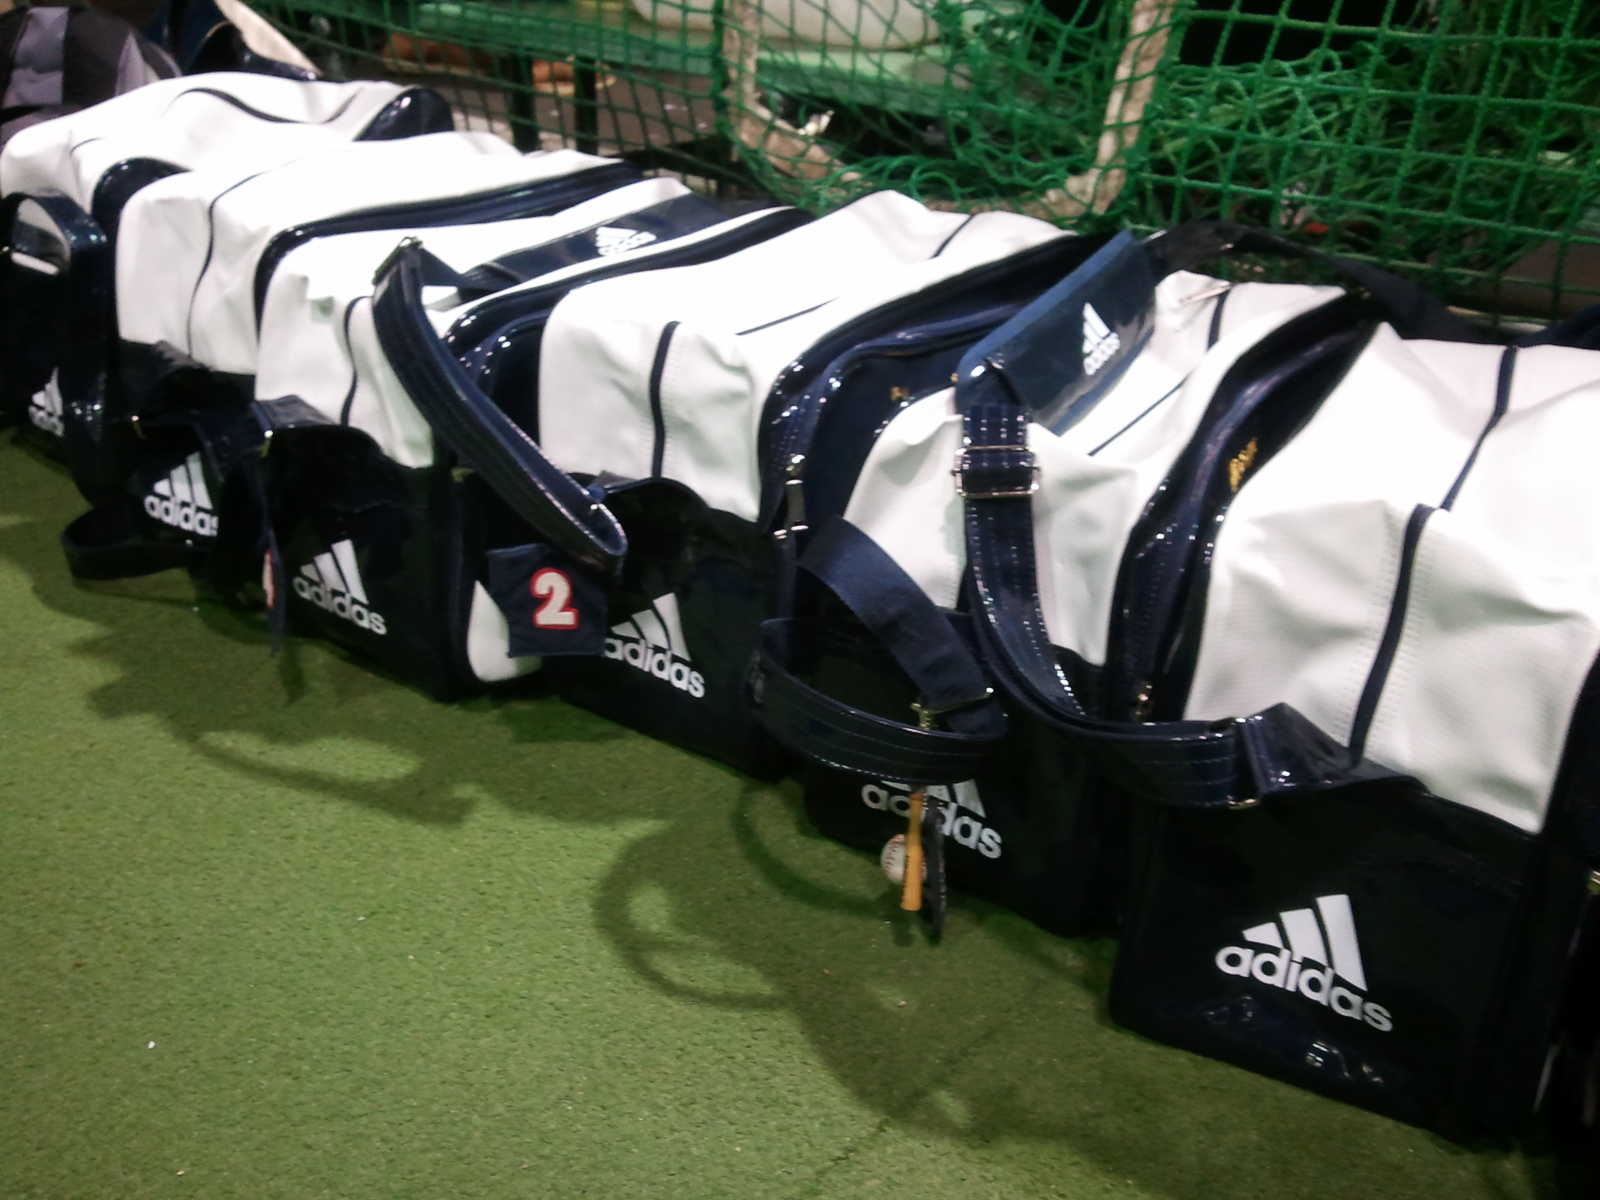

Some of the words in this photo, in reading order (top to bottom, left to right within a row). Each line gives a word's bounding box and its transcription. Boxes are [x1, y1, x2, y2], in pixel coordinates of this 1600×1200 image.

[293, 576, 387, 635] adidas
[530, 567, 580, 630] 2
[604, 636, 705, 698] adidas
[1215, 945, 1393, 1032] adidas
